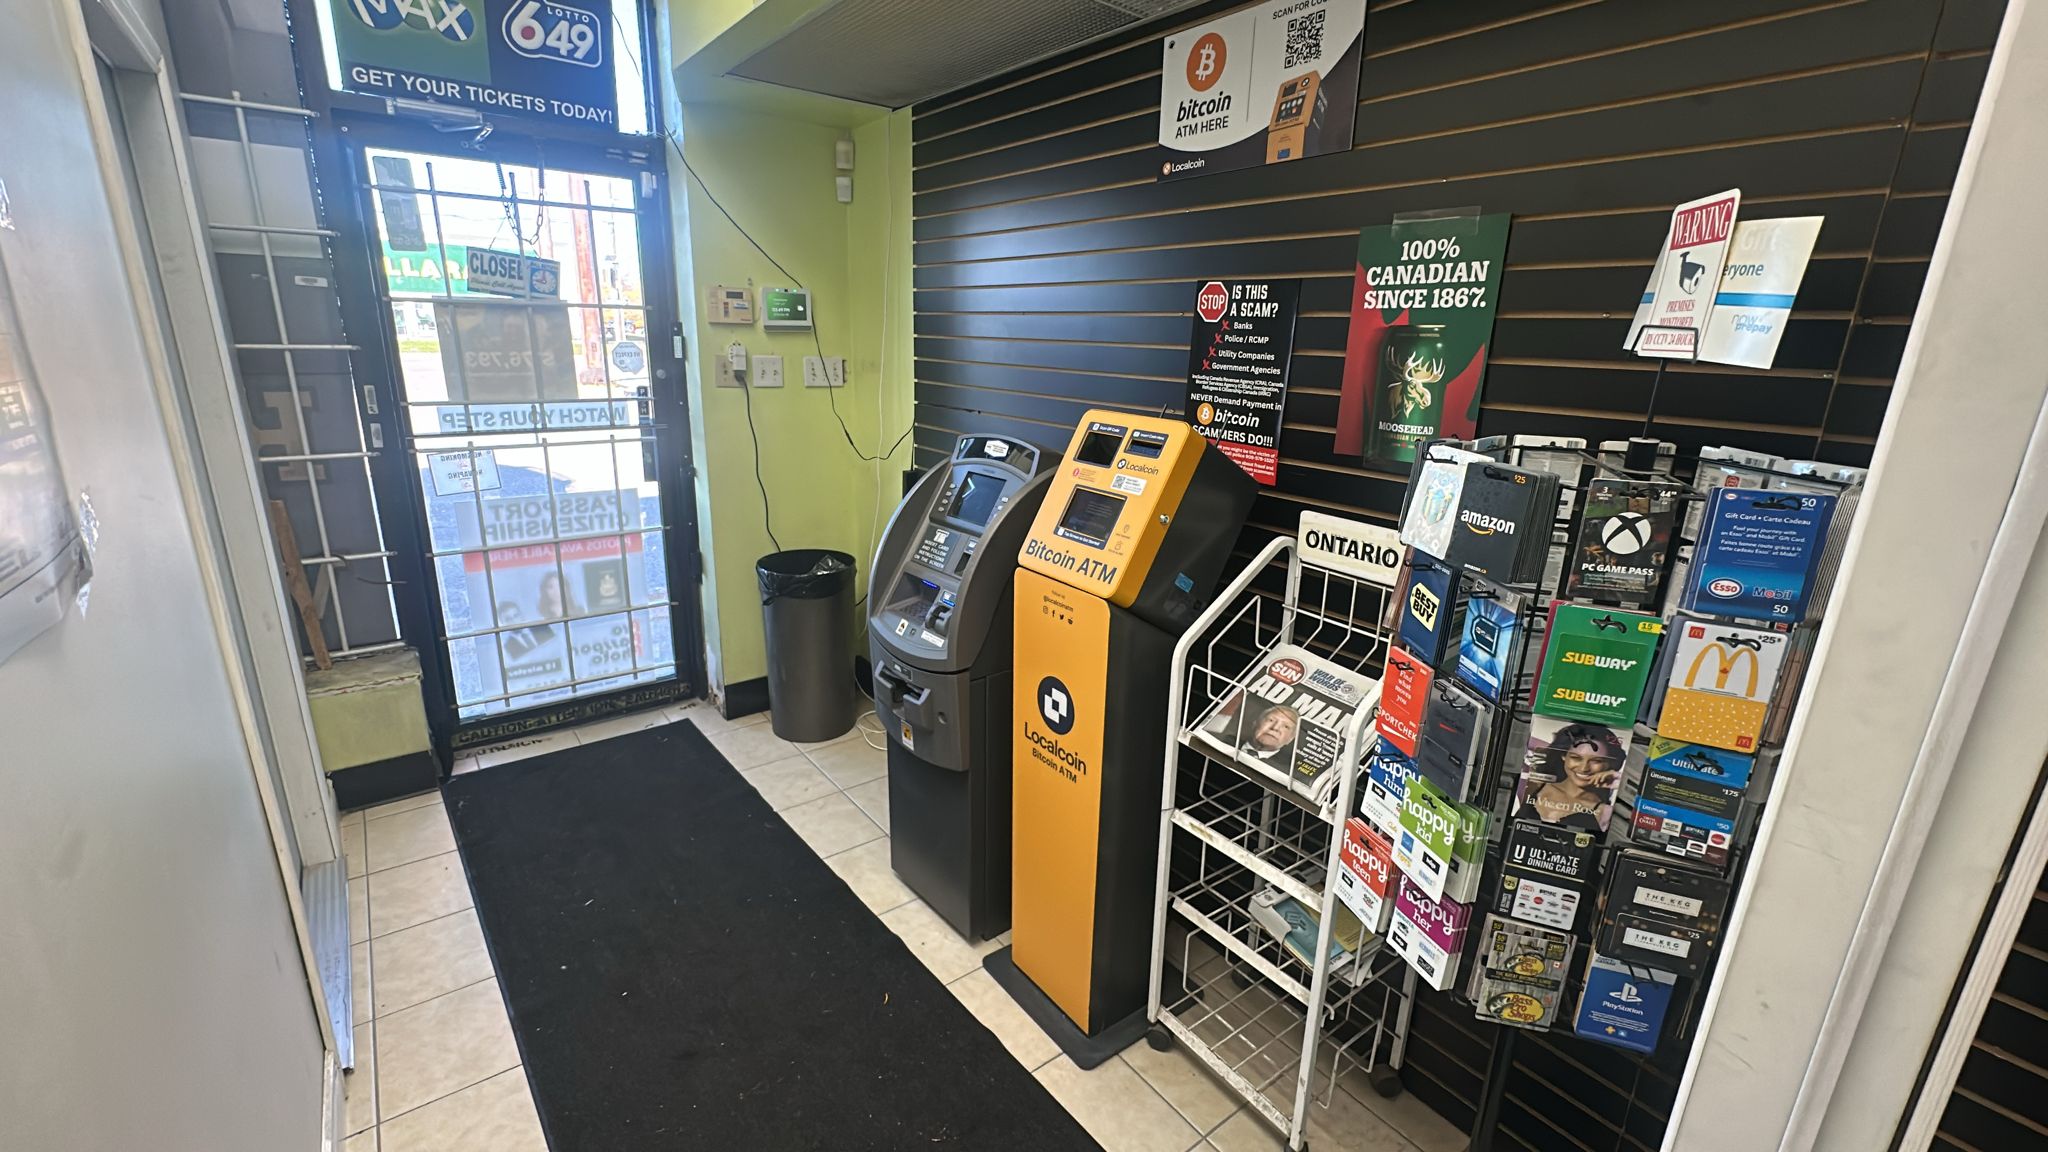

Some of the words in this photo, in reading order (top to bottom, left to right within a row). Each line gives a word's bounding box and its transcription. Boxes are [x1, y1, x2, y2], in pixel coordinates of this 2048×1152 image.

[547, 6, 590, 23] LOTTO
[1273, 6, 1294, 20] SCAN
[1294, 1, 1310, 13] FOR
[351, 66, 396, 88] GET
[401, 75, 462, 99] YOUR
[465, 85, 546, 112] TICKETS
[550, 100, 613, 124] TODAY!
[1176, 91, 1232, 122] bitcoin
[1175, 121, 1198, 139] ATM
[1200, 115, 1229, 134] HERE
[1171, 158, 1205, 173] Localcoin
[1674, 202, 1732, 246] WARNING
[1401, 237, 1461, 261] 100%
[1366, 261, 1490, 286] CANADIAN
[1722, 263, 1763, 280] eryone
[1232, 285, 1242, 299] IS
[1245, 285, 1268, 299] THIS
[1364, 288, 1427, 310] SINCE
[1431, 287, 1487, 308] 1867.
[1201, 294, 1225, 310] STOP
[1666, 300, 1696, 312] PREMISES
[1229, 303, 1237, 316] A
[1240, 303, 1279, 318] SCAM?
[1233, 322, 1253, 330] Banks
[1734, 322, 1772, 334] prepay
[1224, 335, 1244, 343] Police
[1218, 350, 1237, 360] Utility
[1238, 352, 1275, 361] Companies
[1211, 362, 1249, 373] Government
[1250, 366, 1281, 375] Agencies
[1191, 393, 1213, 403] NEVER
[1213, 396, 1241, 406] Demand
[1242, 399, 1274, 409] Payment
[1275, 403, 1282, 411] in
[1214, 408, 1260, 428] bitcoin
[1378, 421, 1434, 435] MOOSEHEAD
[1247, 434, 1273, 447] DO!!!
[1125, 462, 1159, 476] Localcoin
[1514, 474, 1527, 485] $25
[1801, 498, 1817, 507] 50
[1461, 508, 1515, 535] amazon
[1763, 515, 1783, 523] Carte
[1783, 517, 1811, 526] Cadeau
[1305, 530, 1399, 568] ONTARIO
[1025, 539, 1076, 570] Bitcoin
[1077, 557, 1118, 585] ATM
[1581, 563, 1595, 572] PC
[1596, 564, 1628, 574] GAME
[1628, 567, 1654, 576] PASS
[1414, 588, 1437, 614] BEST
[1752, 587, 1792, 601] Mobil
[1413, 600, 1433, 623] BUY
[1773, 604, 1789, 614] 50
[1562, 652, 1638, 671] SUBWAY
[1271, 662, 1302, 682] SUN
[1314, 668, 1336, 683] WAR
[1334, 676, 1347, 686] OF
[1400, 670, 1413, 683] Find
[1248, 674, 1294, 705] AD
[1309, 673, 1341, 692] WORDS
[1398, 679, 1413, 691] what
[1394, 685, 1412, 700] moves
[1396, 695, 1407, 705] you
[1552, 687, 1627, 708] SUBWAY
[1377, 705, 1417, 742] SPORTCHEK
[458, 721, 528, 743] CAUTION
[1024, 722, 1087, 776] Localcoin
[1032, 748, 1058, 772] Bitcoin
[1058, 766, 1077, 784] ATM
[1650, 771, 1677, 783] Ultimate
[1383, 773, 1404, 798] him
[1722, 788, 1739, 798] $175
[1526, 794, 1536, 805] la
[1554, 801, 1570, 812] en
[1571, 803, 1601, 816] Rose
[1642, 804, 1669, 816] Ultimate
[1403, 786, 1455, 846] happy
[1415, 822, 1432, 845] kid
[1716, 822, 1730, 830] $50
[1343, 828, 1388, 883] happy
[1513, 844, 1526, 859] U
[1352, 859, 1371, 884] teen
[1527, 858, 1554, 871] DINING
[1555, 863, 1577, 876] CARD
[1634, 869, 1647, 878] $25
[1400, 874, 1454, 936] happy
[1646, 893, 1665, 902] THE
[1670, 898, 1691, 908] KEG
[1413, 908, 1432, 932] her
[1635, 934, 1654, 943] THE
[1659, 940, 1680, 949] KEG
[1688, 931, 1700, 939] $25
[1511, 994, 1533, 1007] Bass
[1513, 1002, 1528, 1012] Pro
[1602, 1000, 1644, 1016] PlayStation
[1507, 1010, 1536, 1021] Shops
